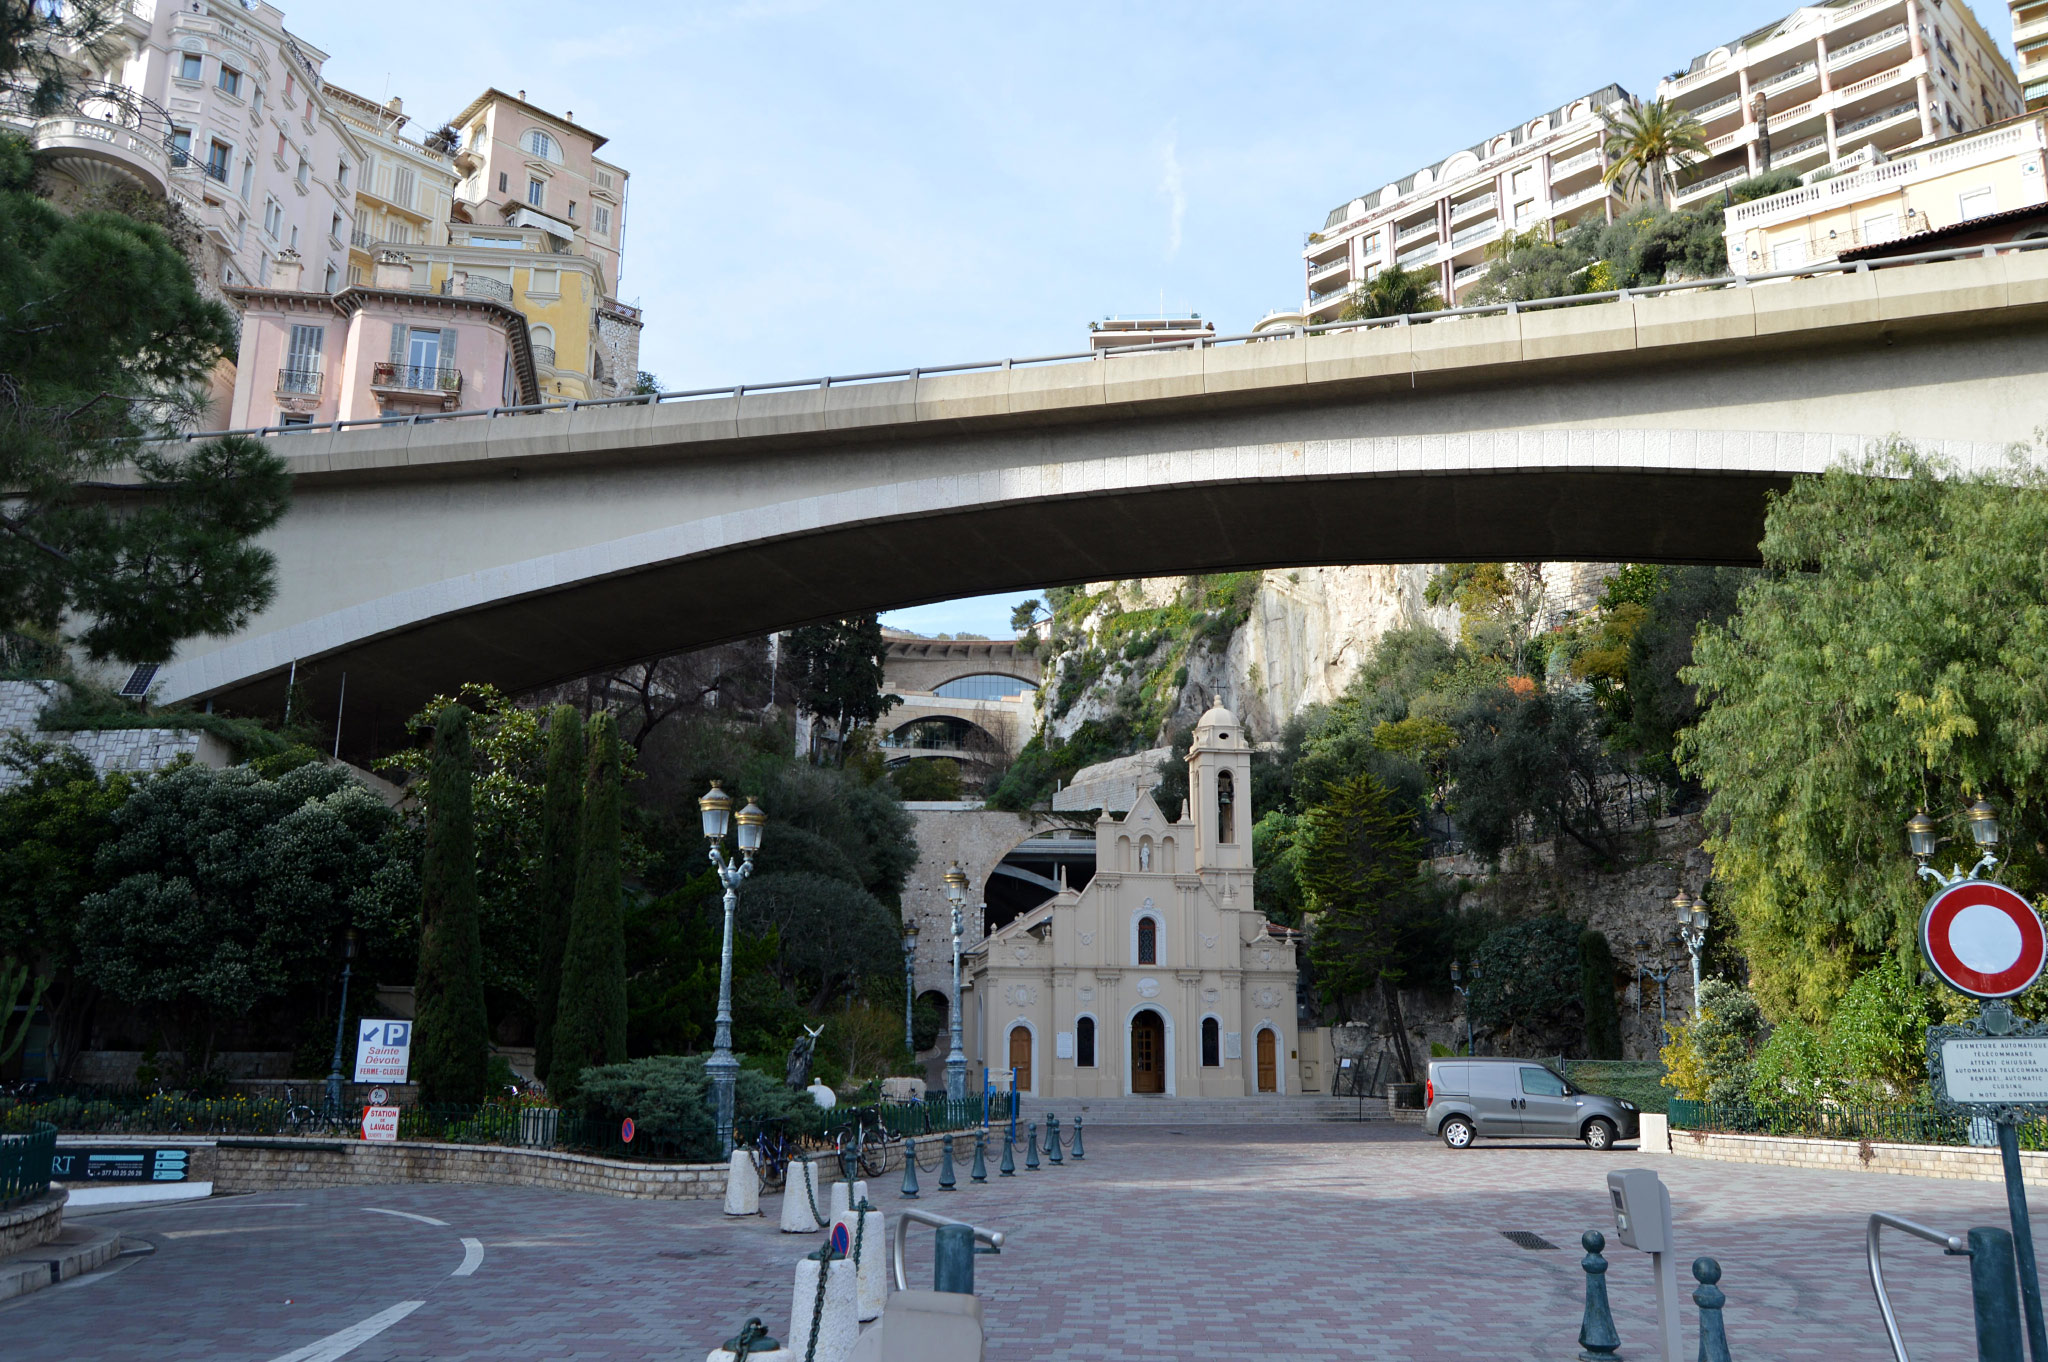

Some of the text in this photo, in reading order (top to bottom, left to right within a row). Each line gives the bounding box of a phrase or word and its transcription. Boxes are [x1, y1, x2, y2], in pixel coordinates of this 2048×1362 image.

[387, 1024, 404, 1045] P
[368, 1046, 399, 1055] Sainte
[365, 1056, 400, 1064] Dévote
